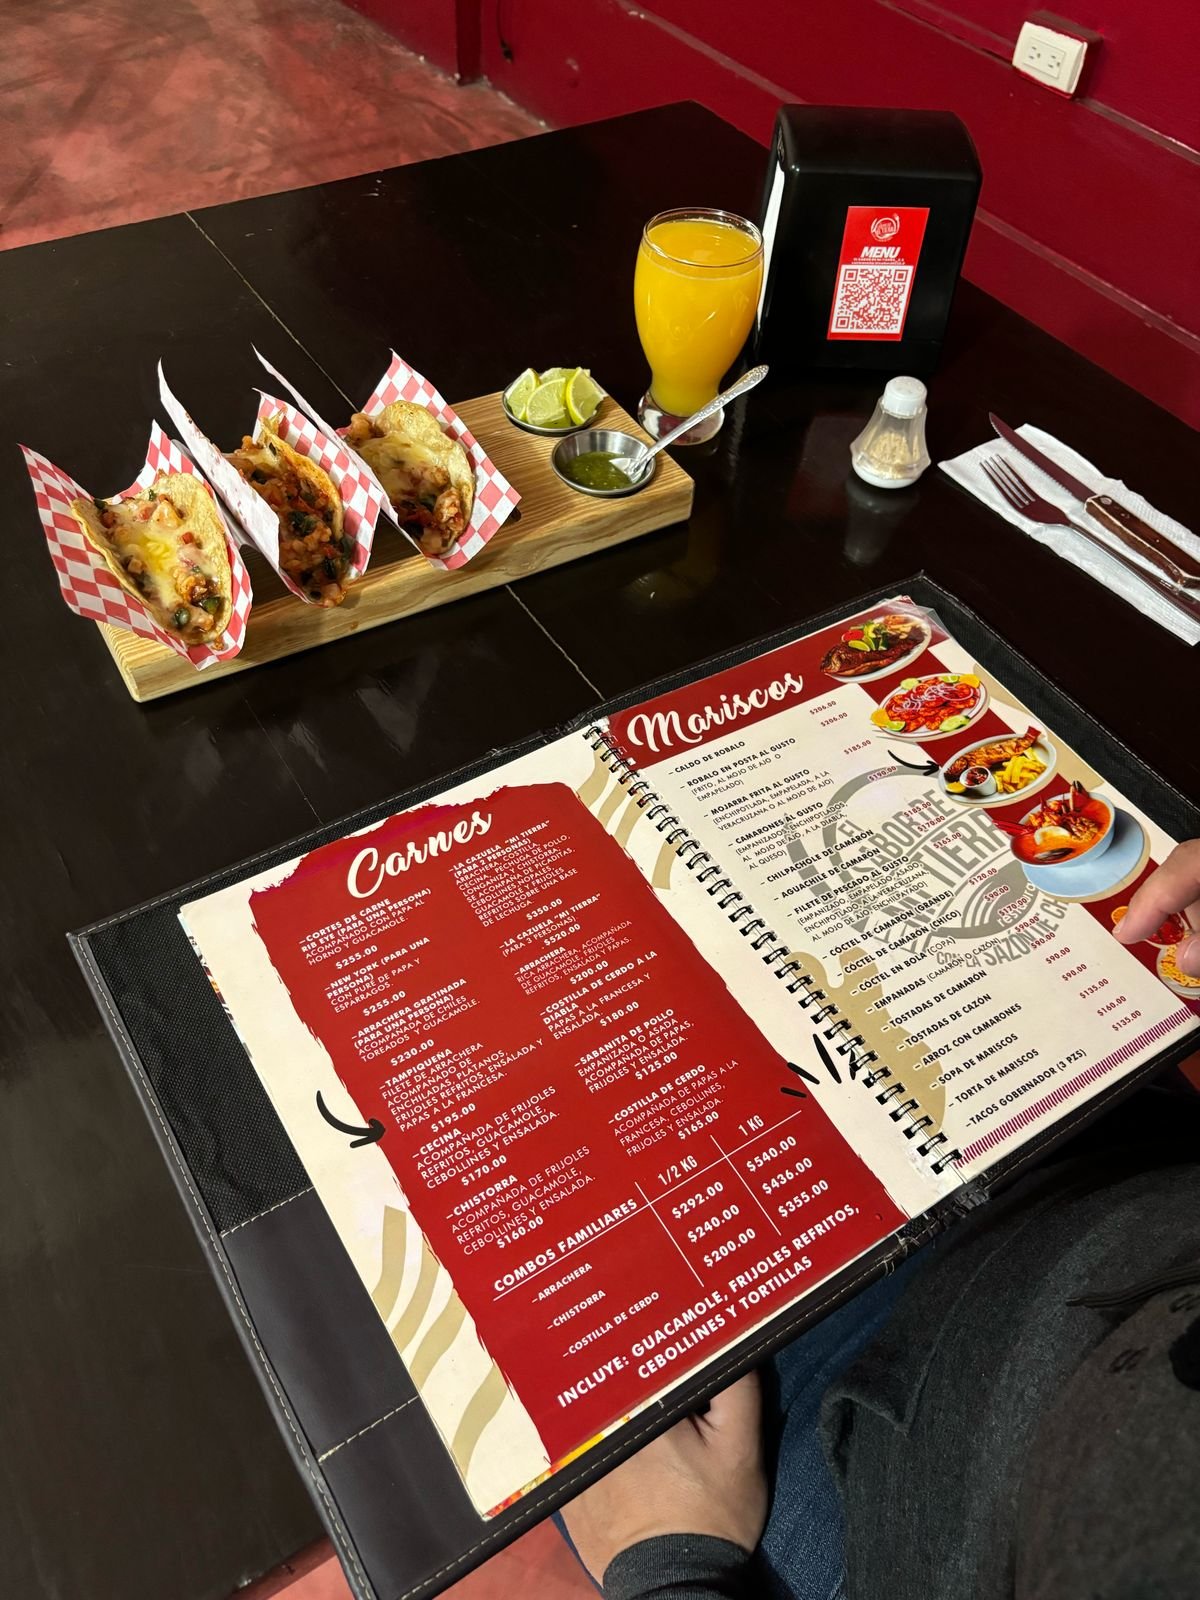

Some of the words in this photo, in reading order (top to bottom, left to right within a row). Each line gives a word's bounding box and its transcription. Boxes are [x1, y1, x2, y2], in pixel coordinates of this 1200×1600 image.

[860, 246, 901, 259] MENU
[627, 672, 803, 752] Mariscos
[674, 759, 701, 773] CALDO
[713, 741, 746, 758] ROBALO
[686, 770, 719, 787] ROBALO
[732, 754, 759, 768] POSTA
[769, 737, 796, 752] GUSTO
[710, 795, 749, 816] MOJARRA
[748, 785, 773, 799] FRITA
[783, 769, 810, 784] GUSTO
[347, 811, 492, 898] Carnes
[465, 844, 502, 865] CAZUELA
[766, 853, 822, 883] CHILPACHOLE
[526, 898, 563, 921] $350.00
[301, 941, 318, 953] RIB
[318, 932, 336, 945] EYE
[365, 909, 387, 922] UNA
[543, 923, 581, 946] $520.00
[335, 944, 378, 970] $255.00
[352, 961, 380, 977] YORK
[409, 937, 430, 950] UNA
[569, 960, 609, 985] $200.00
[604, 962, 635, 982] CERDO
[362, 990, 406, 1017] $255.00
[542, 1002, 579, 1025] DIABLA
[547, 1013, 577, 1033] PAPAS
[598, 978, 644, 1005] FRANCESA
[599, 1001, 639, 1027] $180.00
[643, 1008, 674, 1030] POLLO
[889, 999, 934, 1028] TOSTADAS
[577, 1041, 637, 1077] EMPANIZADA
[648, 1018, 679, 1038] ASADA
[904, 1017, 950, 1046] TOSTADAS
[922, 1043, 953, 1066] ARROZ
[952, 1032, 973, 1048] CON
[971, 1002, 1022, 1036] CAMARONES
[390, 1039, 435, 1066] $230.00
[634, 1051, 678, 1080] $125.00
[938, 1066, 964, 1085] SOPA
[975, 1033, 1019, 1062] MARISCOS
[588, 1066, 630, 1094] FRIJOLES
[674, 1064, 706, 1086] CERDO
[954, 1082, 985, 1103] TORTA
[996, 1048, 1039, 1078] MARISCOS
[998, 1067, 1058, 1107] GOBERNADOR
[430, 1102, 476, 1133] $195.00
[677, 1111, 719, 1140] $165.00
[626, 1128, 667, 1157] FRIJOLES
[746, 1136, 797, 1172] $540.00
[461, 1154, 507, 1186] $170.00
[544, 1145, 590, 1178] FRIJOLES
[657, 1165, 682, 1186] 1/2
[761, 1157, 813, 1195] $436.00
[671, 1181, 724, 1219] $292.00
[777, 1179, 829, 1218] $355.00
[463, 1212, 528, 1255] CEBOLLINES
[496, 1215, 544, 1249] $160.00
[687, 1204, 740, 1243] $240.00
[494, 1248, 556, 1292] COMBOS
[557, 1198, 638, 1253] FAMILIARES
[703, 1228, 756, 1267] $200.00
[628, 1291, 660, 1315] CERDO
[638, 1313, 726, 1379] CEBOLLINES
[738, 1255, 812, 1310] TORTILLAS
[557, 1356, 629, 1408] INCLUYE:
[728, 1245, 792, 1293] FRIJOLES
